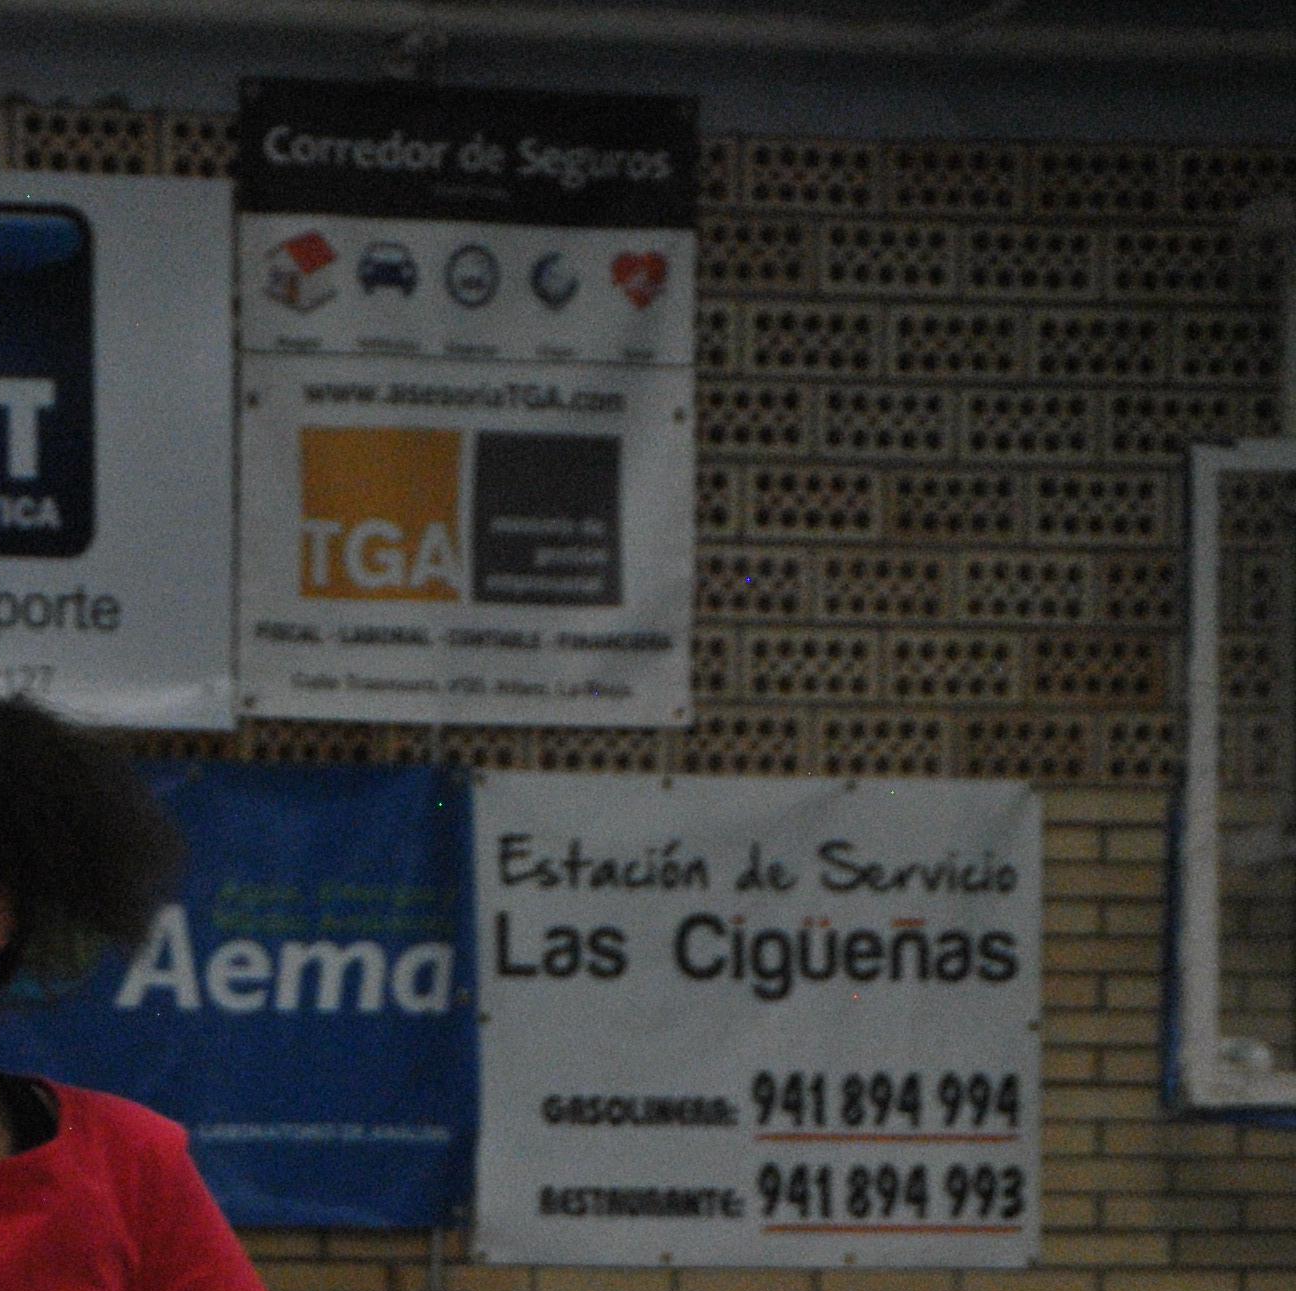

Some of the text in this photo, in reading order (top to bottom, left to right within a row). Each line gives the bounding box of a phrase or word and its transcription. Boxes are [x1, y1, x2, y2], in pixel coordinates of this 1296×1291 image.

[262, 124, 675, 189] Corredor de Seguros
[301, 519, 462, 590] TGA
[497, 833, 1017, 894] Estación de Servicio
[112, 902, 457, 1015] Aema
[495, 911, 1018, 1001] Las Cigüeñas
[753, 1070, 826, 1126] 941
[840, 1073, 923, 1128] 894
[938, 1073, 1021, 1128] 994
[757, 1162, 834, 1219] 941
[847, 1163, 929, 1219] 894
[945, 1164, 1036, 1220] 993
